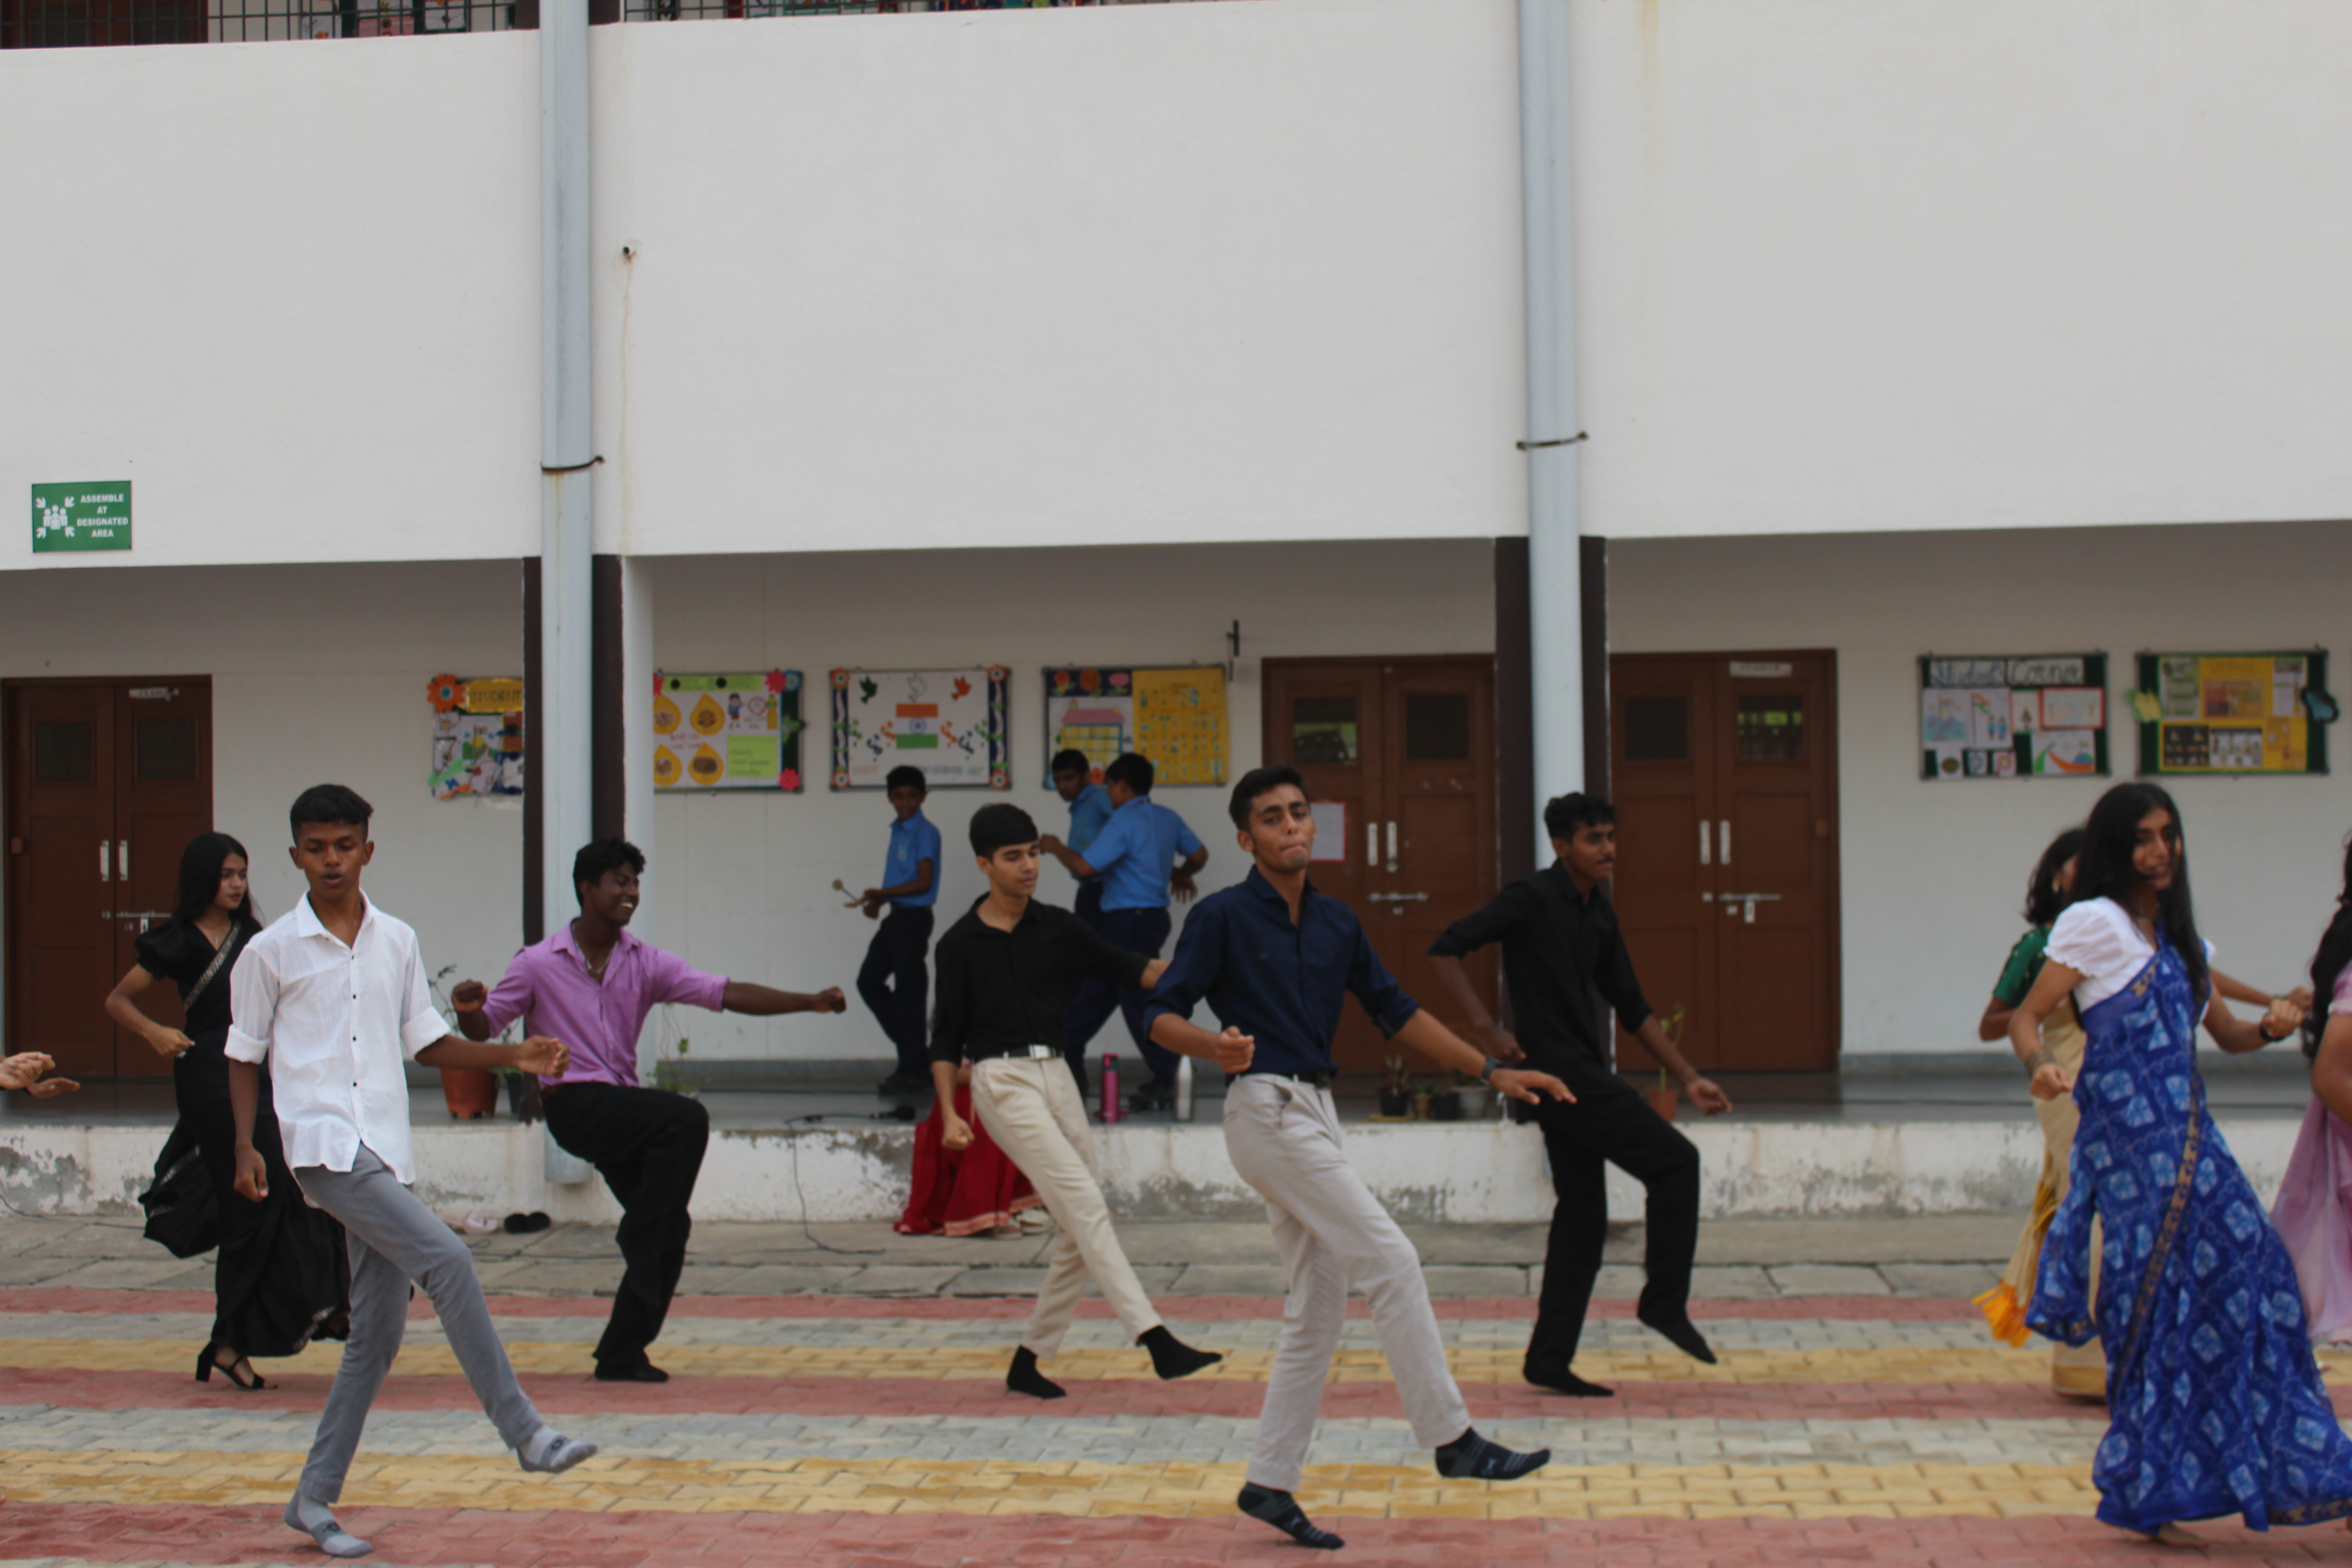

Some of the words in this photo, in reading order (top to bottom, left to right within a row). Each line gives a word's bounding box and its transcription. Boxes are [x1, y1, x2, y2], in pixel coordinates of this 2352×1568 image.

[80, 494, 124, 503] ASSEMBLE
[97, 506, 108, 514] AT
[77, 517, 128, 526] DESIGNATED
[92, 529, 114, 538] AREA
